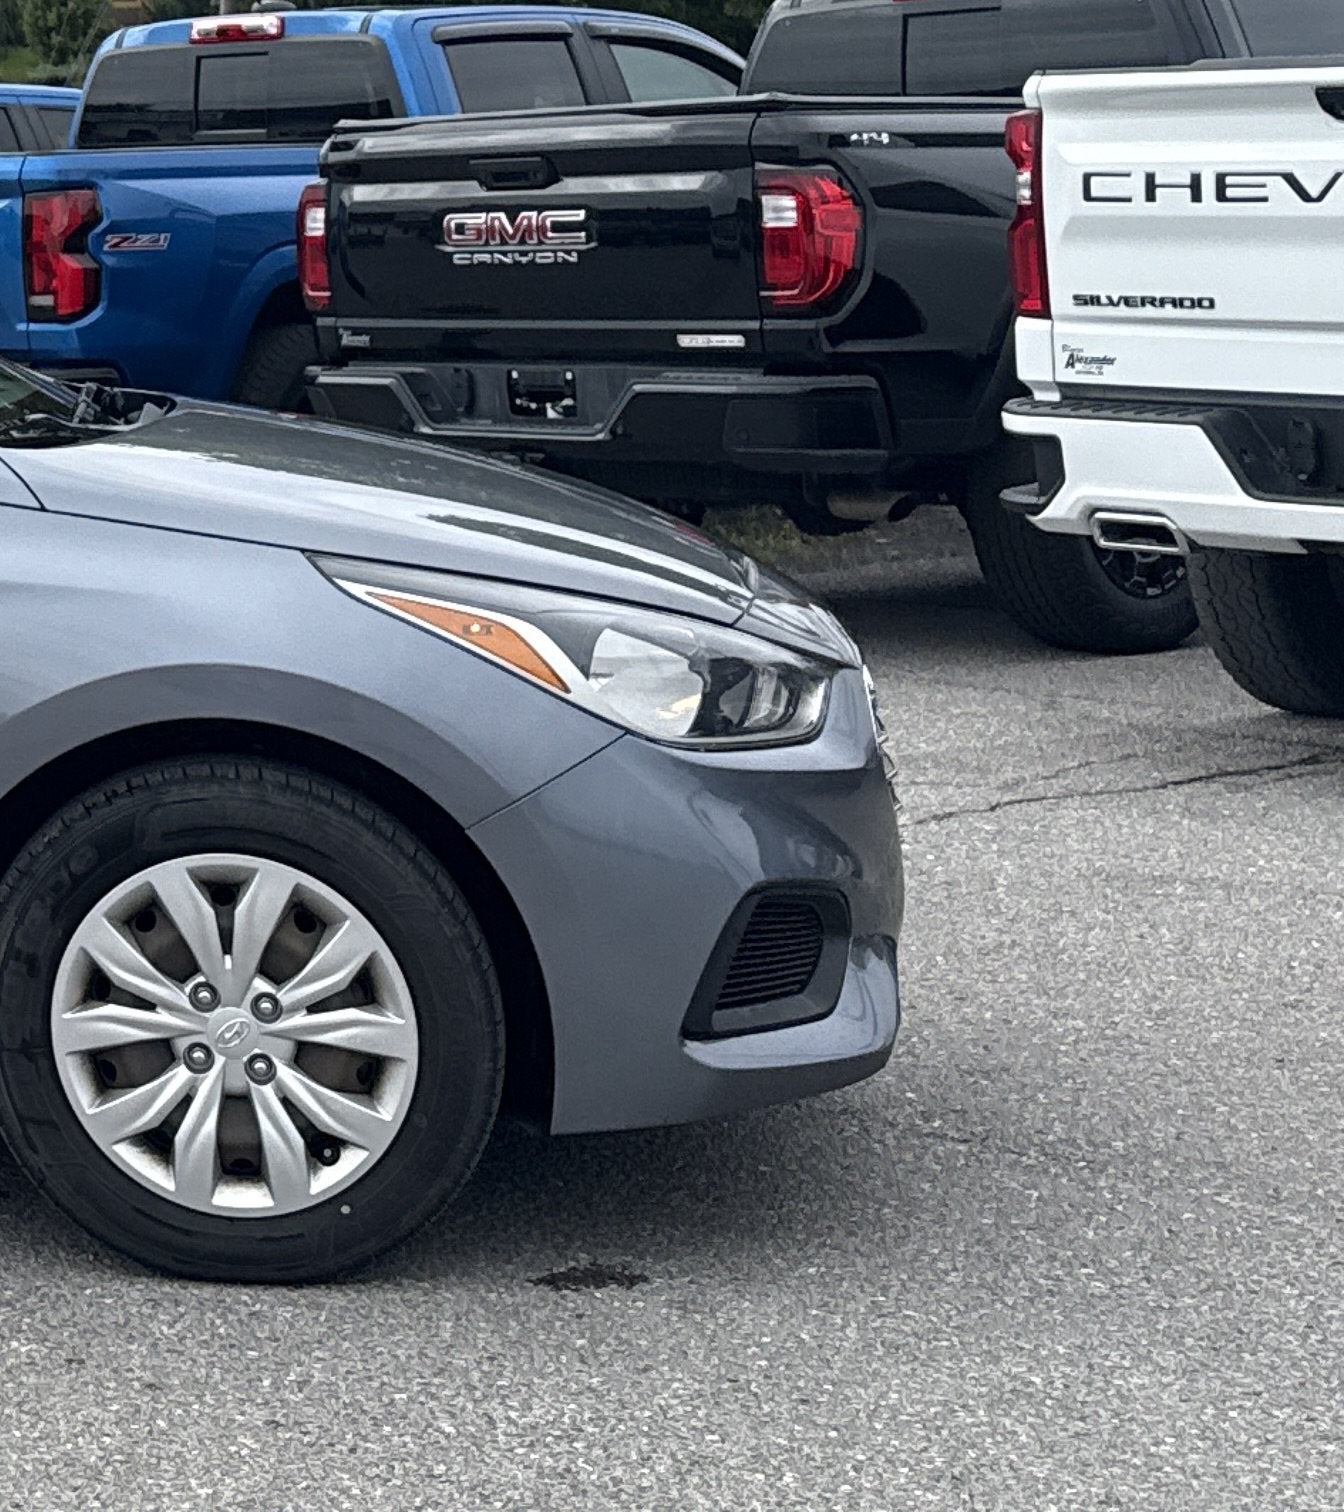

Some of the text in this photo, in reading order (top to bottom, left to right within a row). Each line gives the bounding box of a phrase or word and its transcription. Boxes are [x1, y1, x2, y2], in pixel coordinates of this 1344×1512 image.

[443, 209, 587, 245] GMC
[452, 251, 578, 265] CANYON
[1072, 294, 1215, 310] SILVERADO
